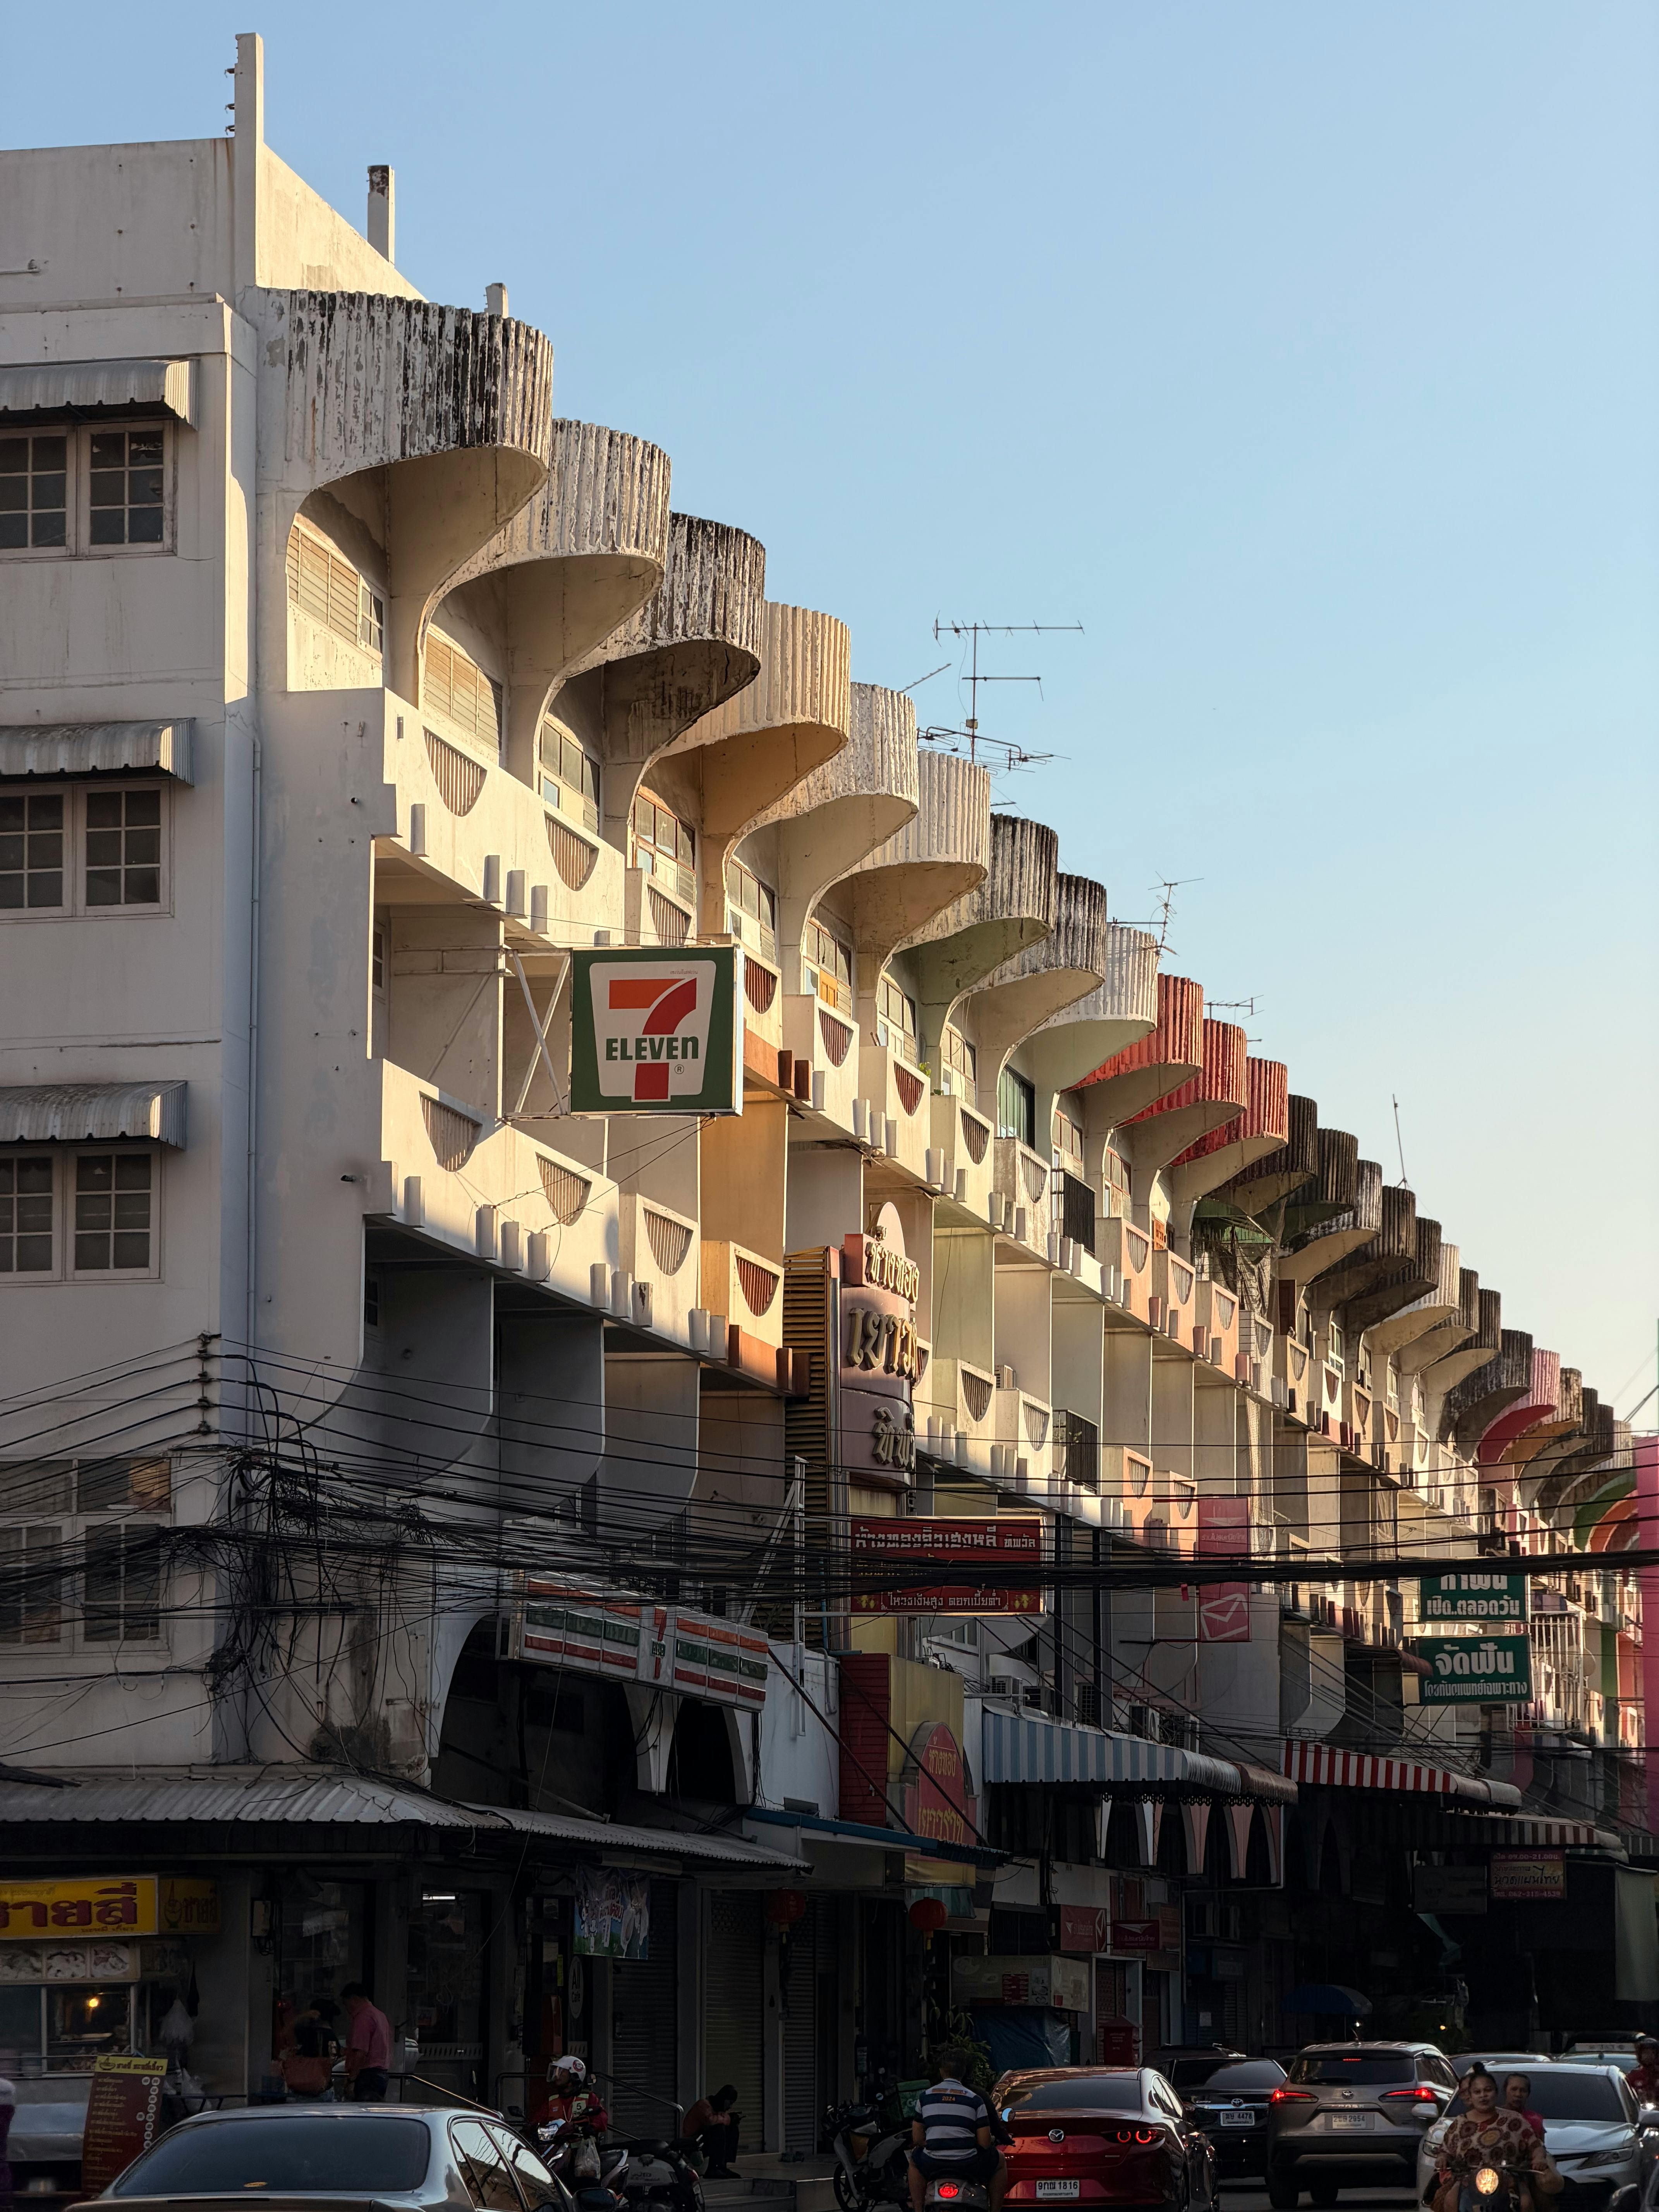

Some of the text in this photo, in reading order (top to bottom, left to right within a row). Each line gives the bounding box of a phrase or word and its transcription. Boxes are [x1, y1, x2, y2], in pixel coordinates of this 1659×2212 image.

[1435, 1642, 1514, 1675] จัดฟัน
[929, 1736, 957, 1778] ห้างทอง
[0, 1882, 137, 1928] ายสี่
[1058, 2181, 1078, 2190] 1816
